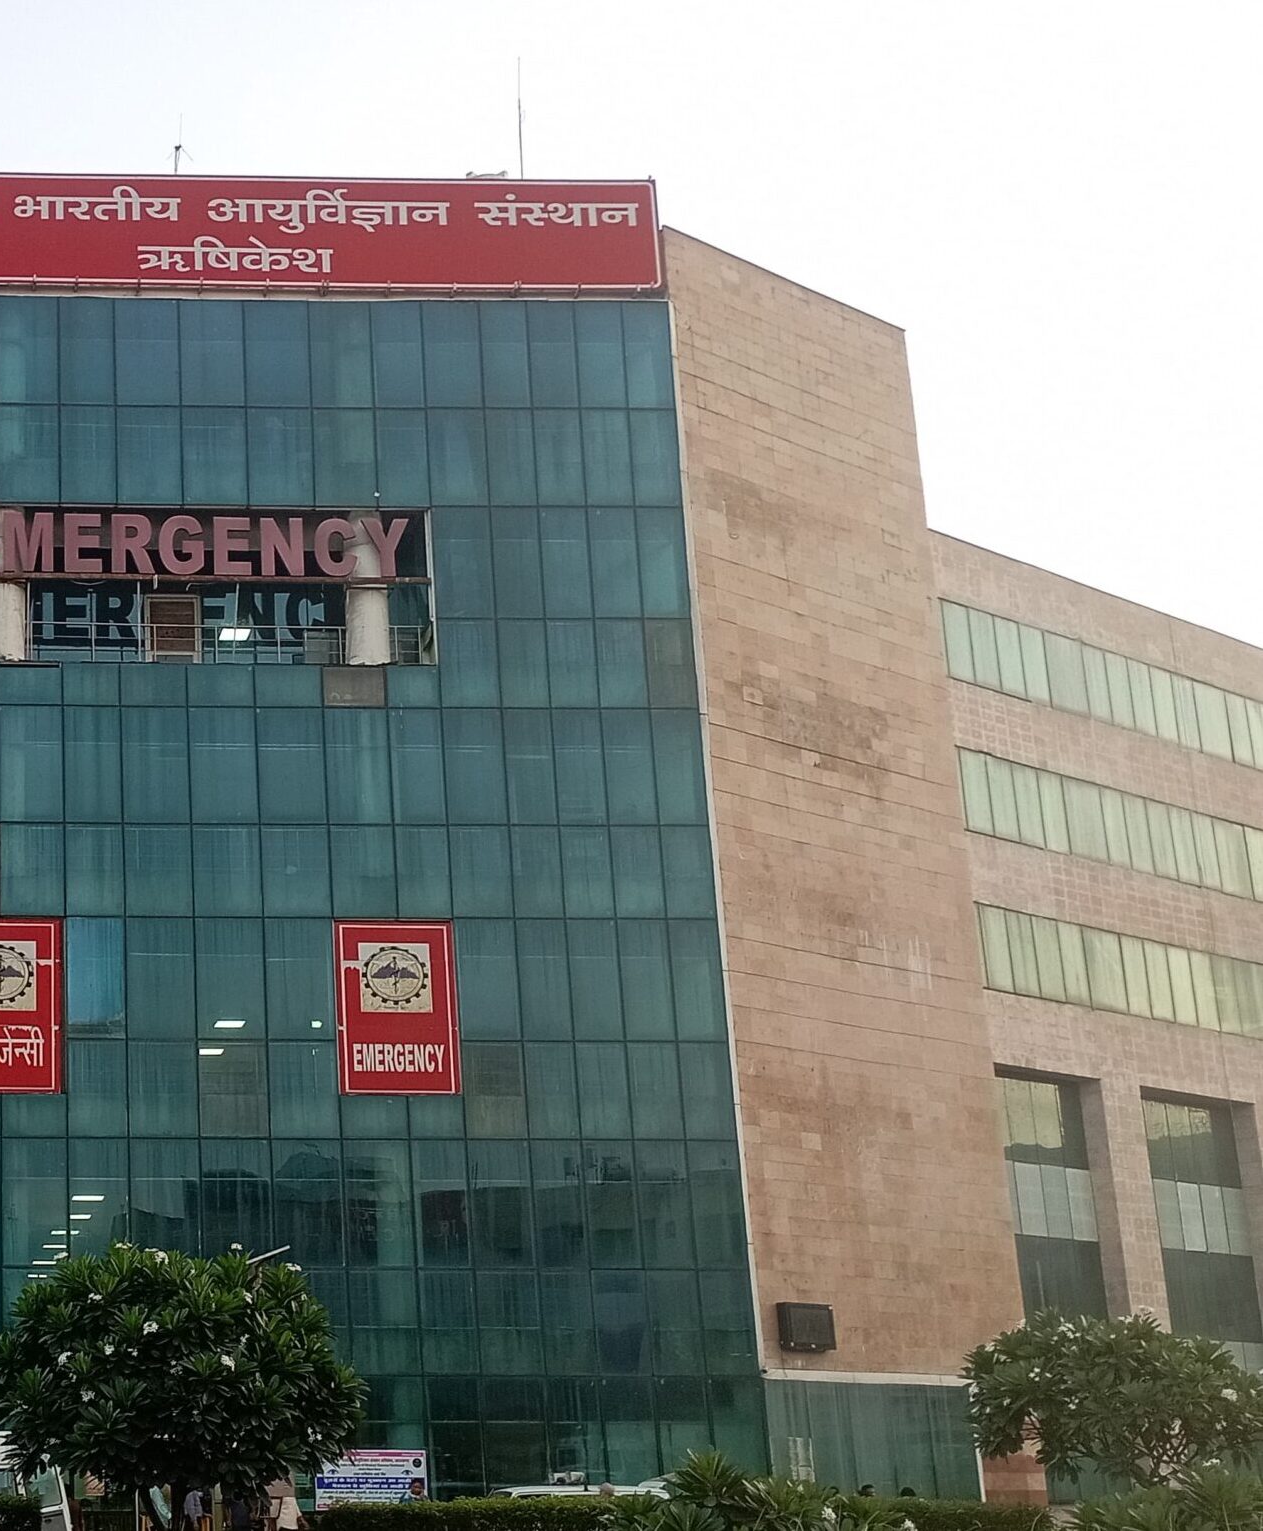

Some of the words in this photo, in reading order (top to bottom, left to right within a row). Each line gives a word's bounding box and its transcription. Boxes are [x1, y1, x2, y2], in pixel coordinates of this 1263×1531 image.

[14, 186, 181, 221] भारतीय
[207, 189, 450, 233] आयुर्विज्ञान
[474, 194, 638, 227] संस्थान
[137, 236, 333, 273] ऋषिकेश
[353, 1043, 445, 1073] EMERGENCY
